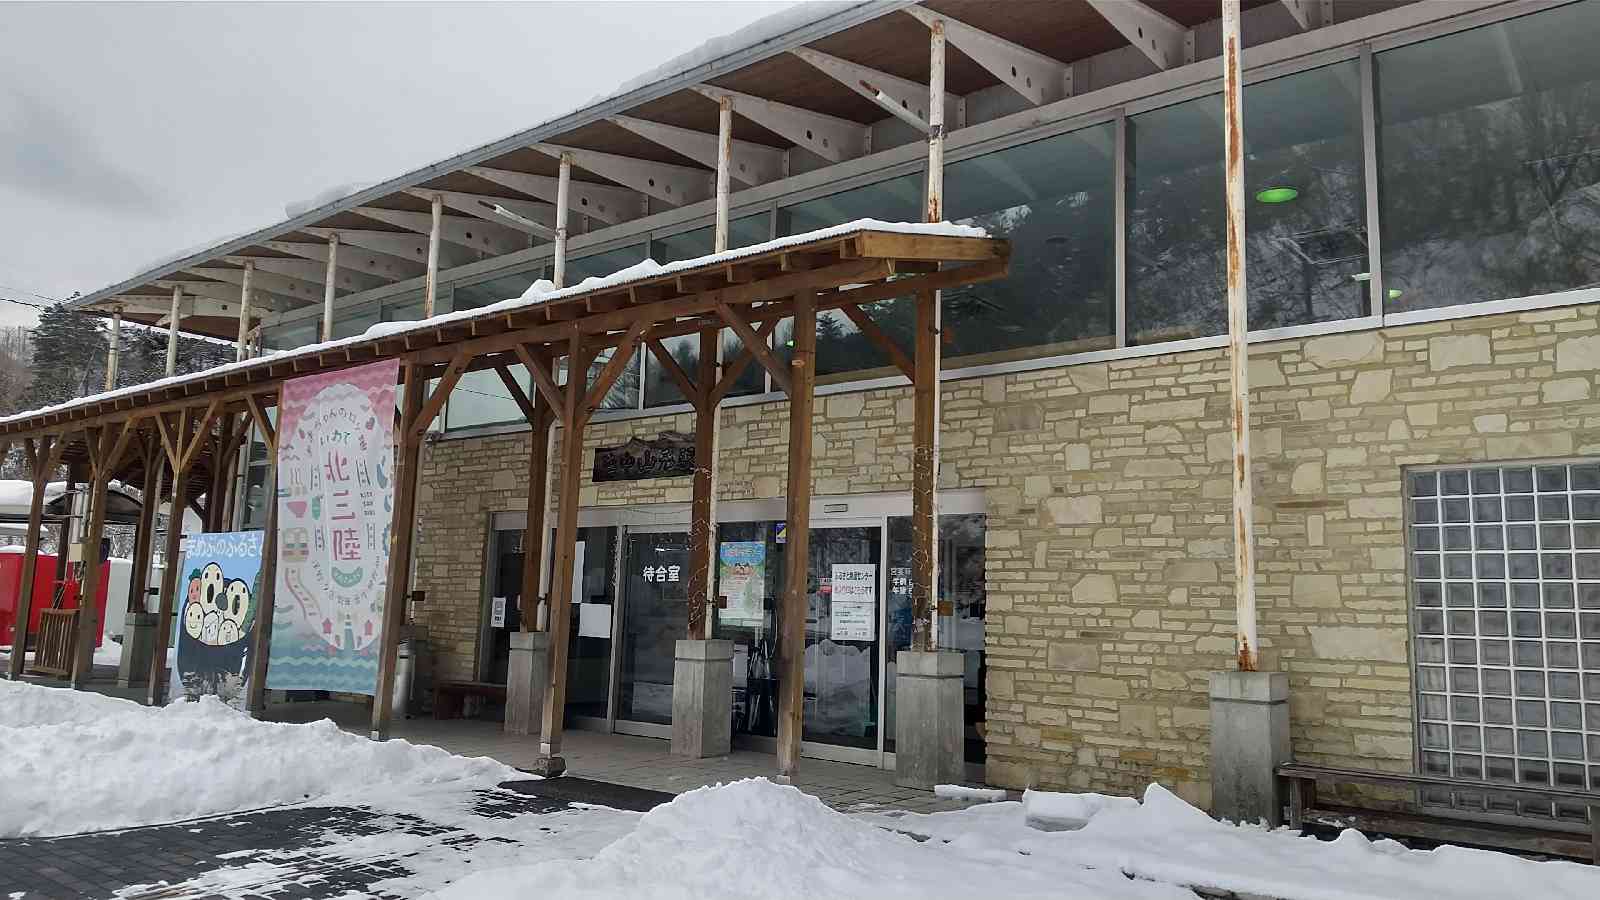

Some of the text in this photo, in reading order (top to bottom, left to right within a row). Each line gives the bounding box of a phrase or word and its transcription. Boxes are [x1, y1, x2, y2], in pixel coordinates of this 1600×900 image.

[320, 430, 351, 446] いわて
[324, 449, 361, 560] 北三陸
[643, 565, 681, 582] 待合室
